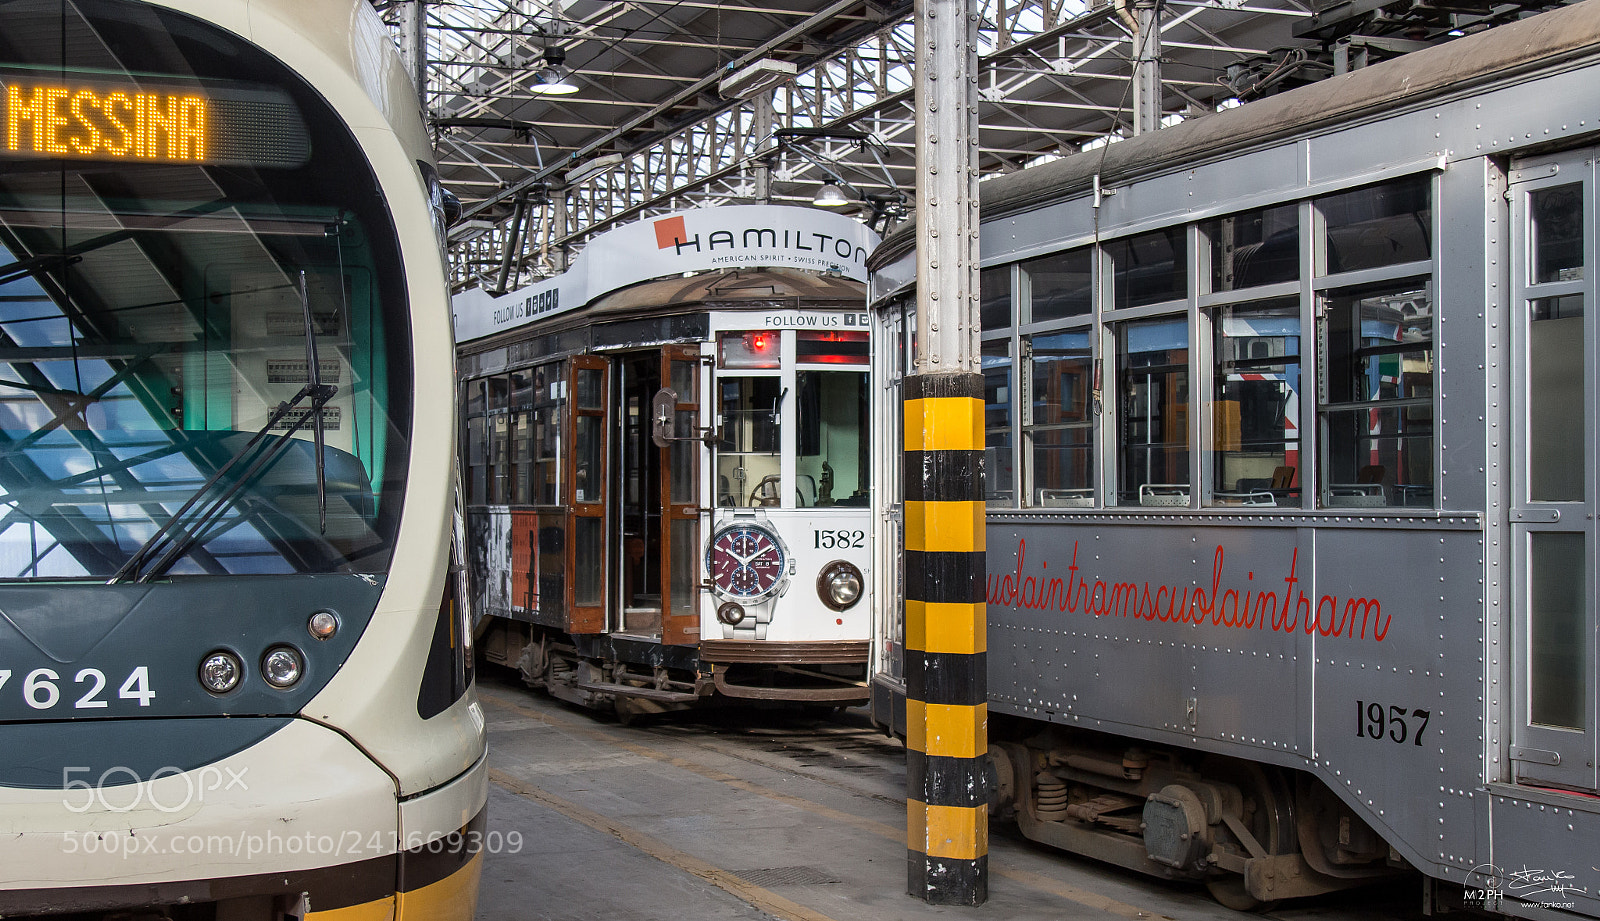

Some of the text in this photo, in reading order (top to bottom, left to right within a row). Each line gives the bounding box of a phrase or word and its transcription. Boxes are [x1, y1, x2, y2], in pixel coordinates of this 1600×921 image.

[8, 85, 206, 161] MESSINA
[674, 228, 869, 267] HAMILTON
[711, 254, 850, 273] AMERICAN SPIRIT SWISS PRECION
[493, 302, 524, 326] FOLLOW US
[765, 316, 838, 327] FOLLOW US
[814, 529, 866, 550] 1582
[985, 538, 1393, 642] uolaintramscuolaintram
[1356, 700, 1431, 747] 1957
